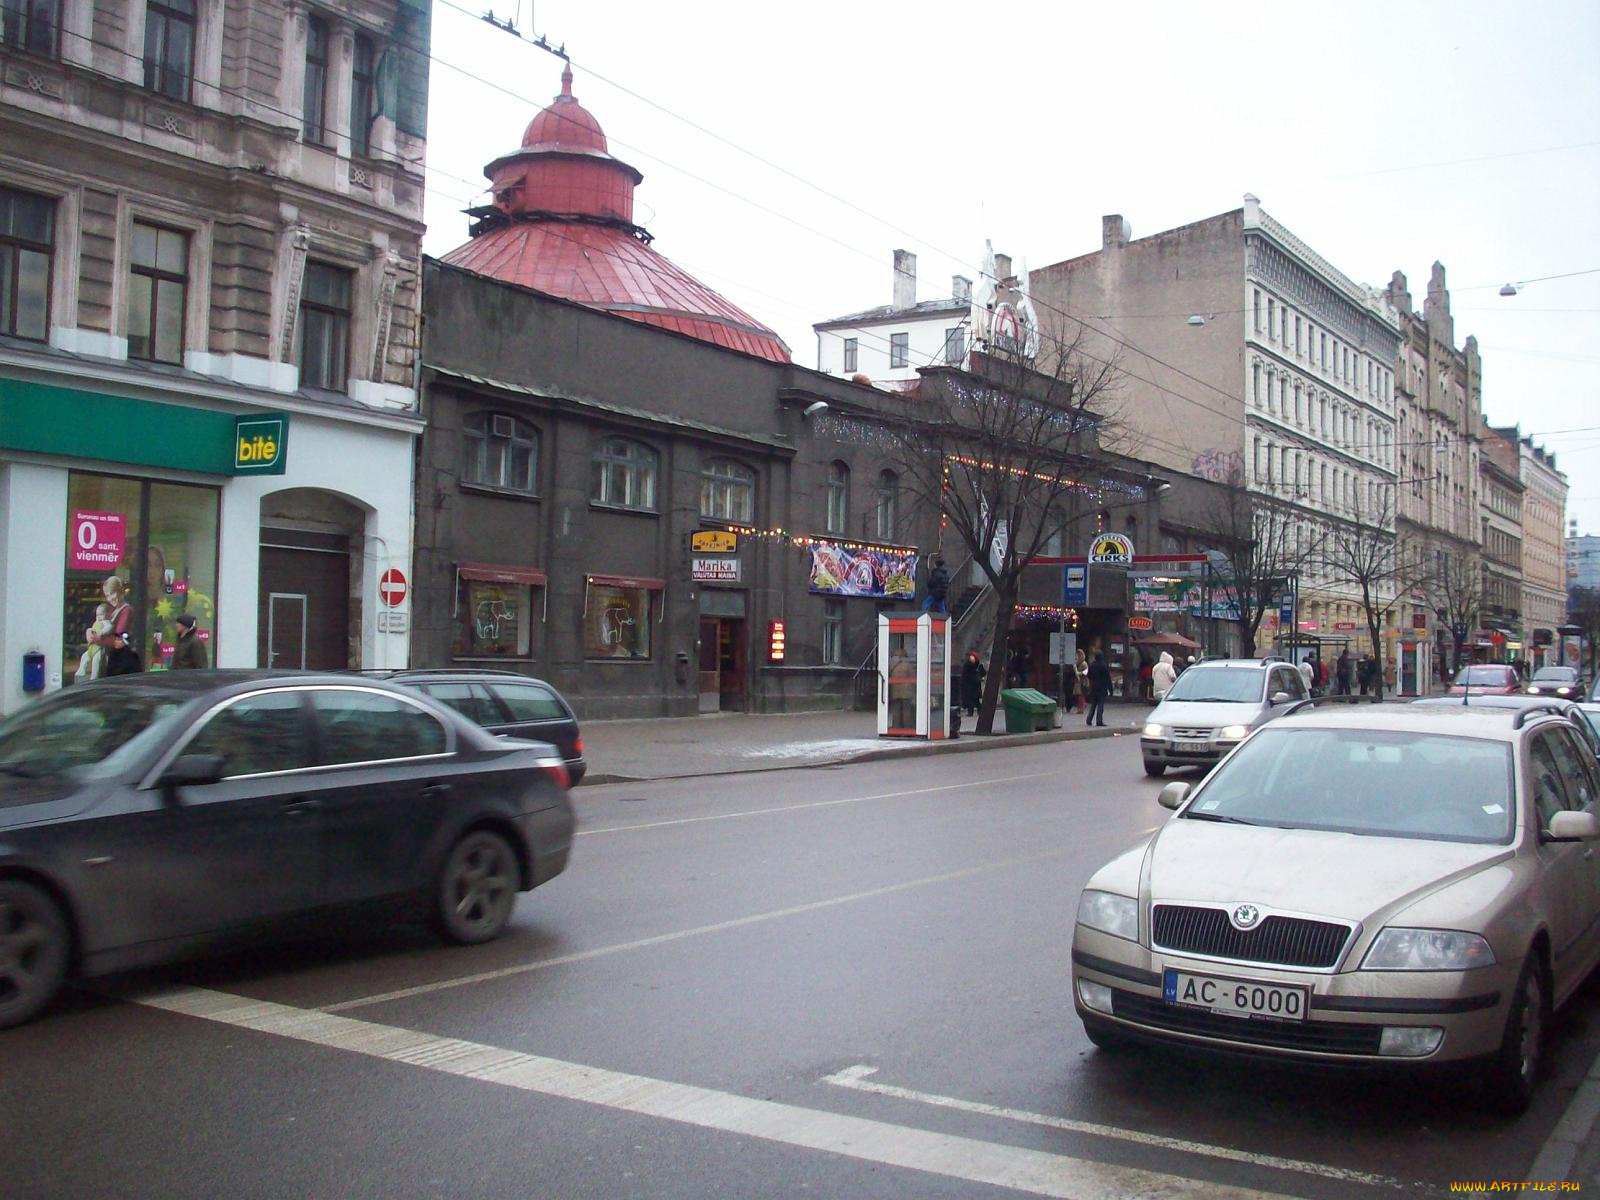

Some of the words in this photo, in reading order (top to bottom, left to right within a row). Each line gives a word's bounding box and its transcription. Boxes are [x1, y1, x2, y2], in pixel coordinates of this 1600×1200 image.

[78, 521, 97, 549] 0
[76, 550, 119, 562] vienmēr
[1091, 554, 1129, 562] CIRKS
[698, 560, 732, 571] Marika
[1183, 978, 1300, 1014] AC-6000
